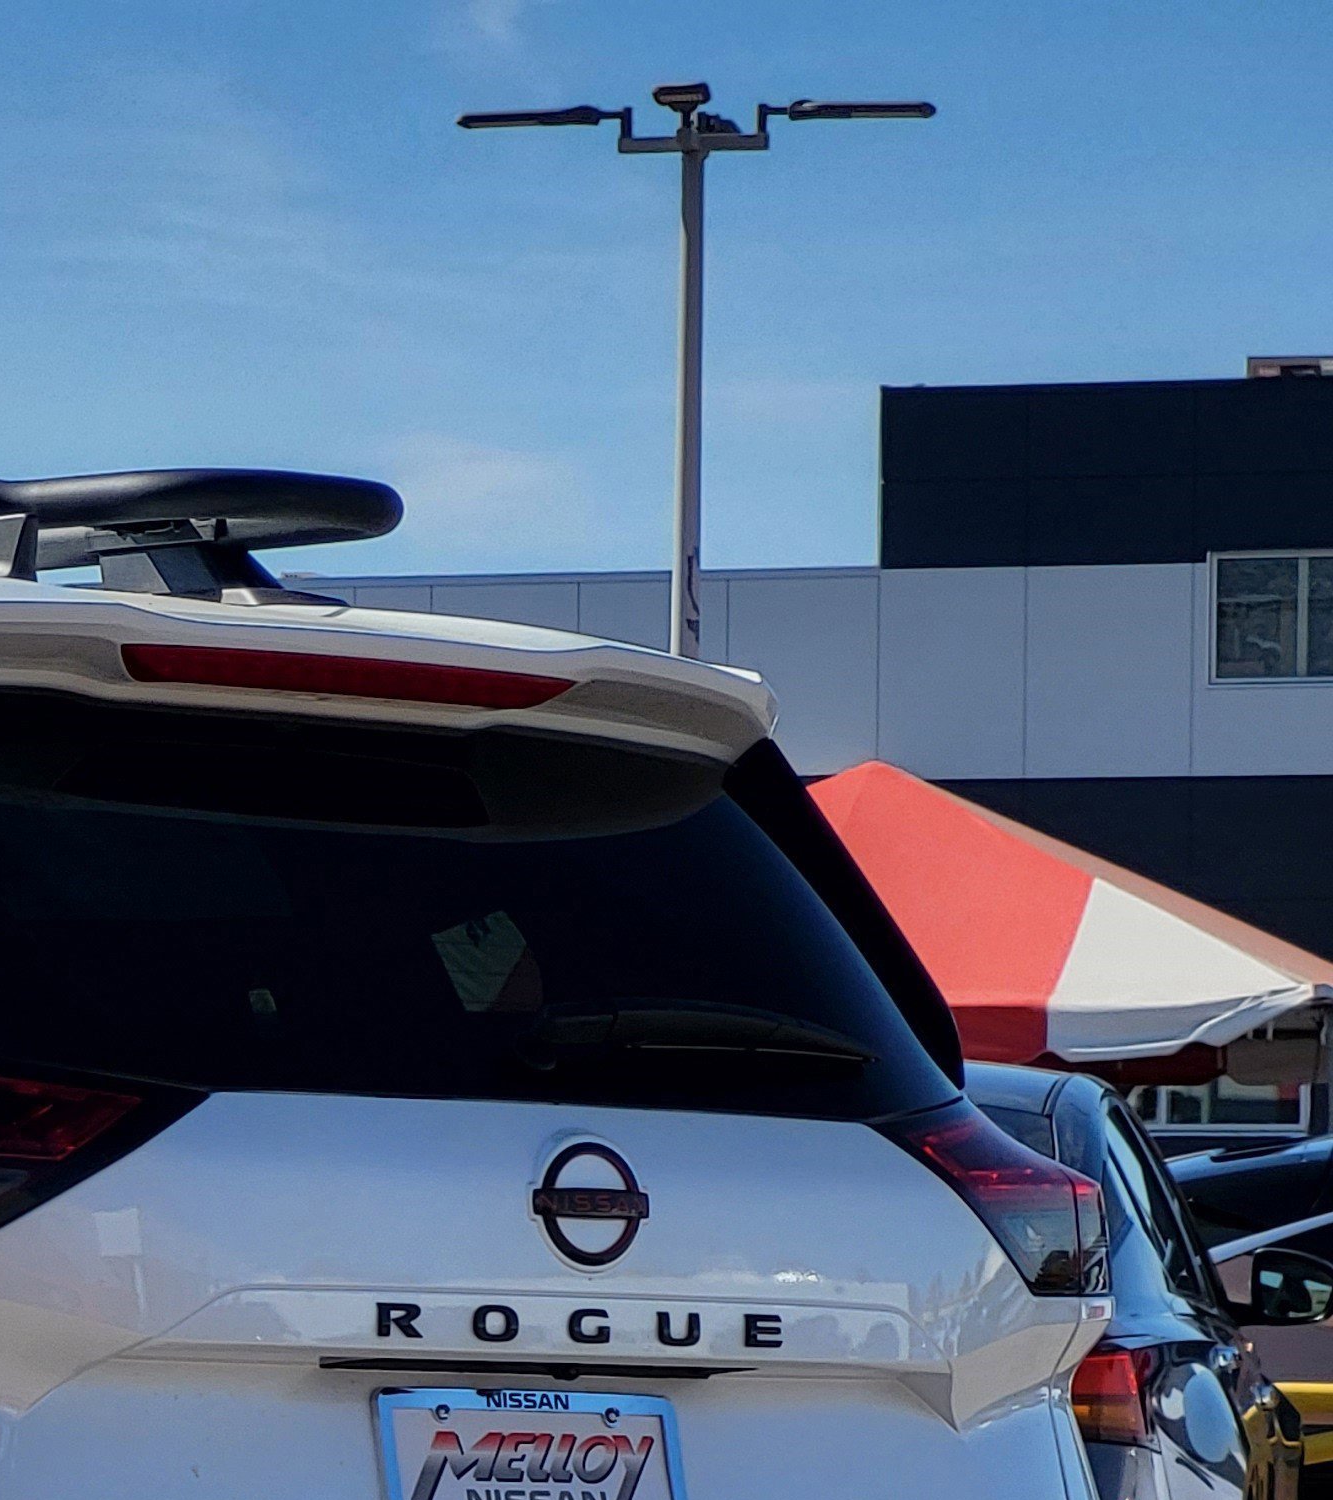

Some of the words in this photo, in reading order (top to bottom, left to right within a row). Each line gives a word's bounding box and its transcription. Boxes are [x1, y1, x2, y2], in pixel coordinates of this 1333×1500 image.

[536, 1193, 645, 1215] NISSAN
[376, 1302, 784, 1348] ROGUE
[485, 1392, 570, 1411] NISSAN
